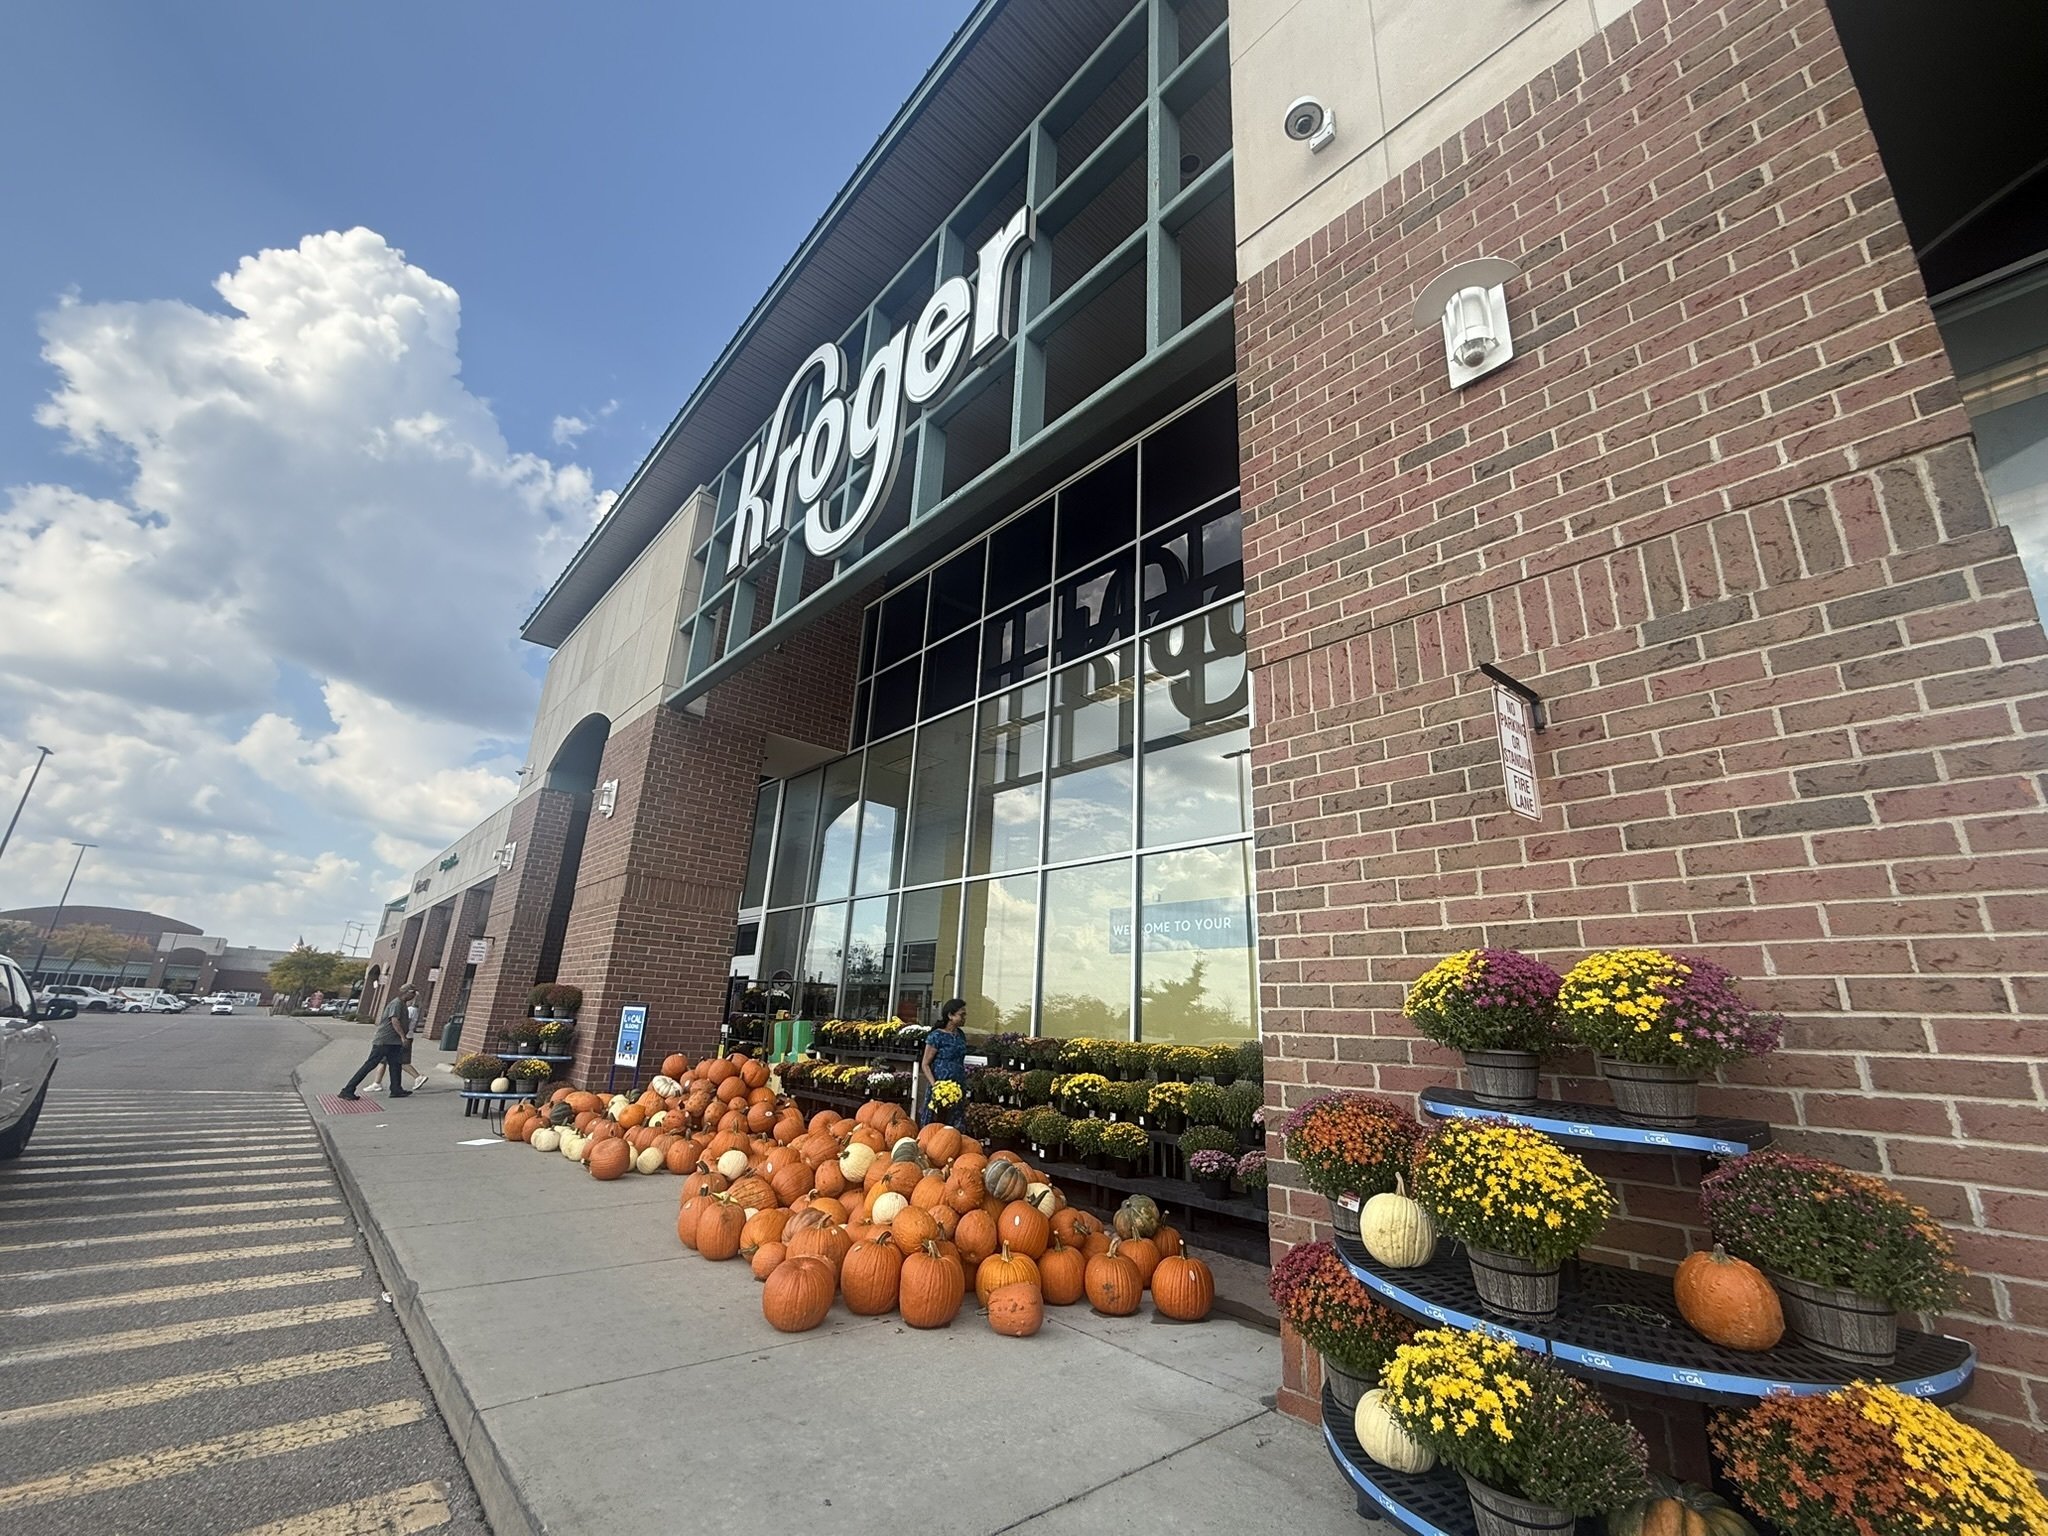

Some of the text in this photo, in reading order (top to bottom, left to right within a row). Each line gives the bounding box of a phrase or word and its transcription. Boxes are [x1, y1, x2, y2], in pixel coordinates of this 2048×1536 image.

[726, 205, 1035, 576] Kroger
[1505, 700, 1516, 716] NO
[1500, 713, 1527, 738] PARKING
[1511, 735, 1521, 751] OR
[1513, 775, 1531, 795] FIRE
[1514, 793, 1535, 813] LANE
[1174, 920, 1191, 932] TO
[1195, 917, 1232, 930] YOUR
[1581, 1354, 1613, 1369] LOCAL
[1672, 1373, 1706, 1386] LOCAL
